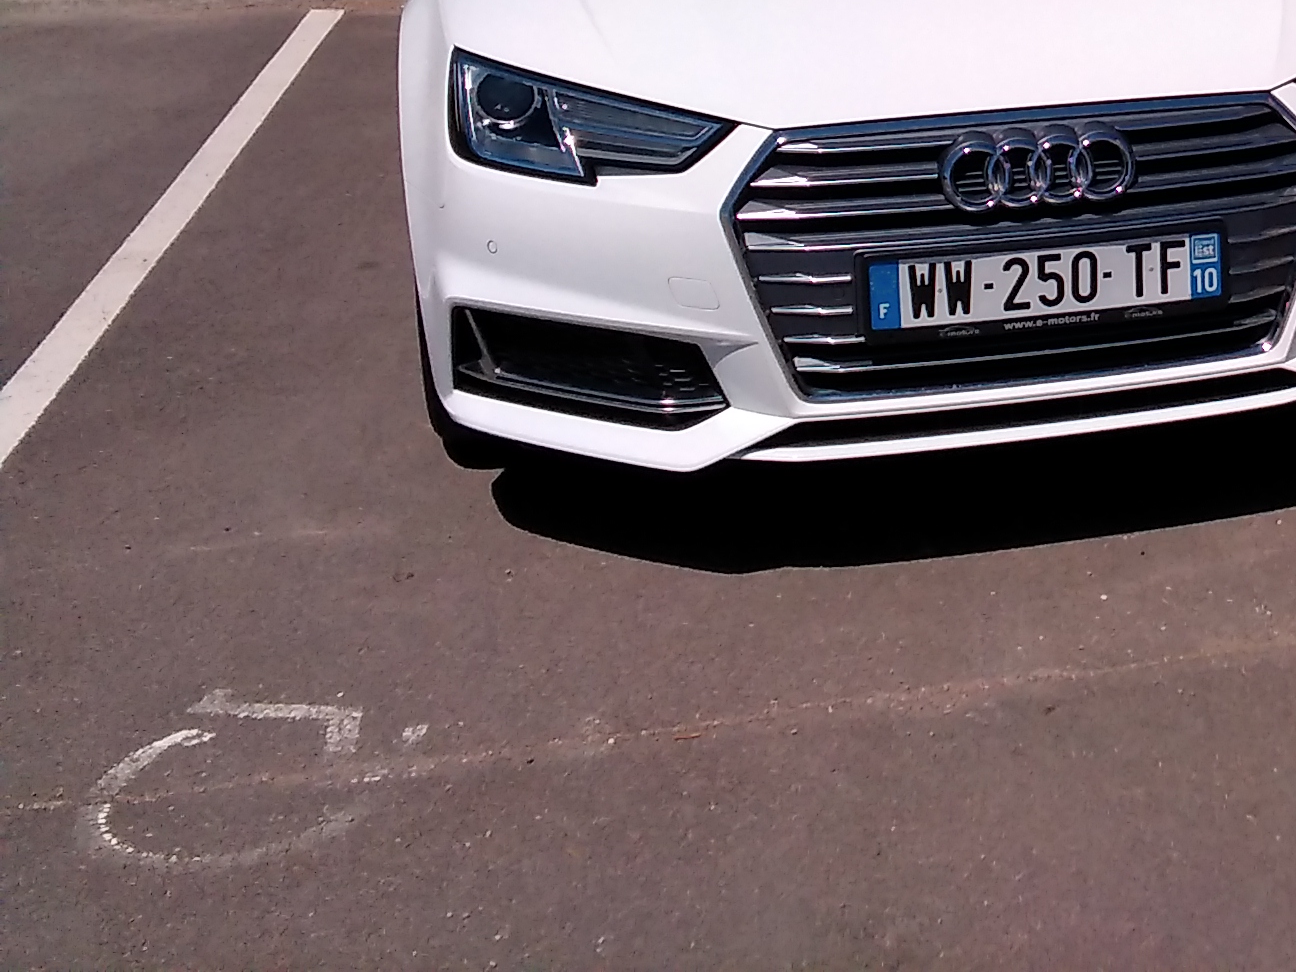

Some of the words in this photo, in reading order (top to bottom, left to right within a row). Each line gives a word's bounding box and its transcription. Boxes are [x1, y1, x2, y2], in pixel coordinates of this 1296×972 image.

[1194, 244, 1215, 257] Est
[1193, 267, 1218, 294] 10
[879, 303, 890, 319] F
[1003, 312, 1100, 331] www.e-motors.fr
